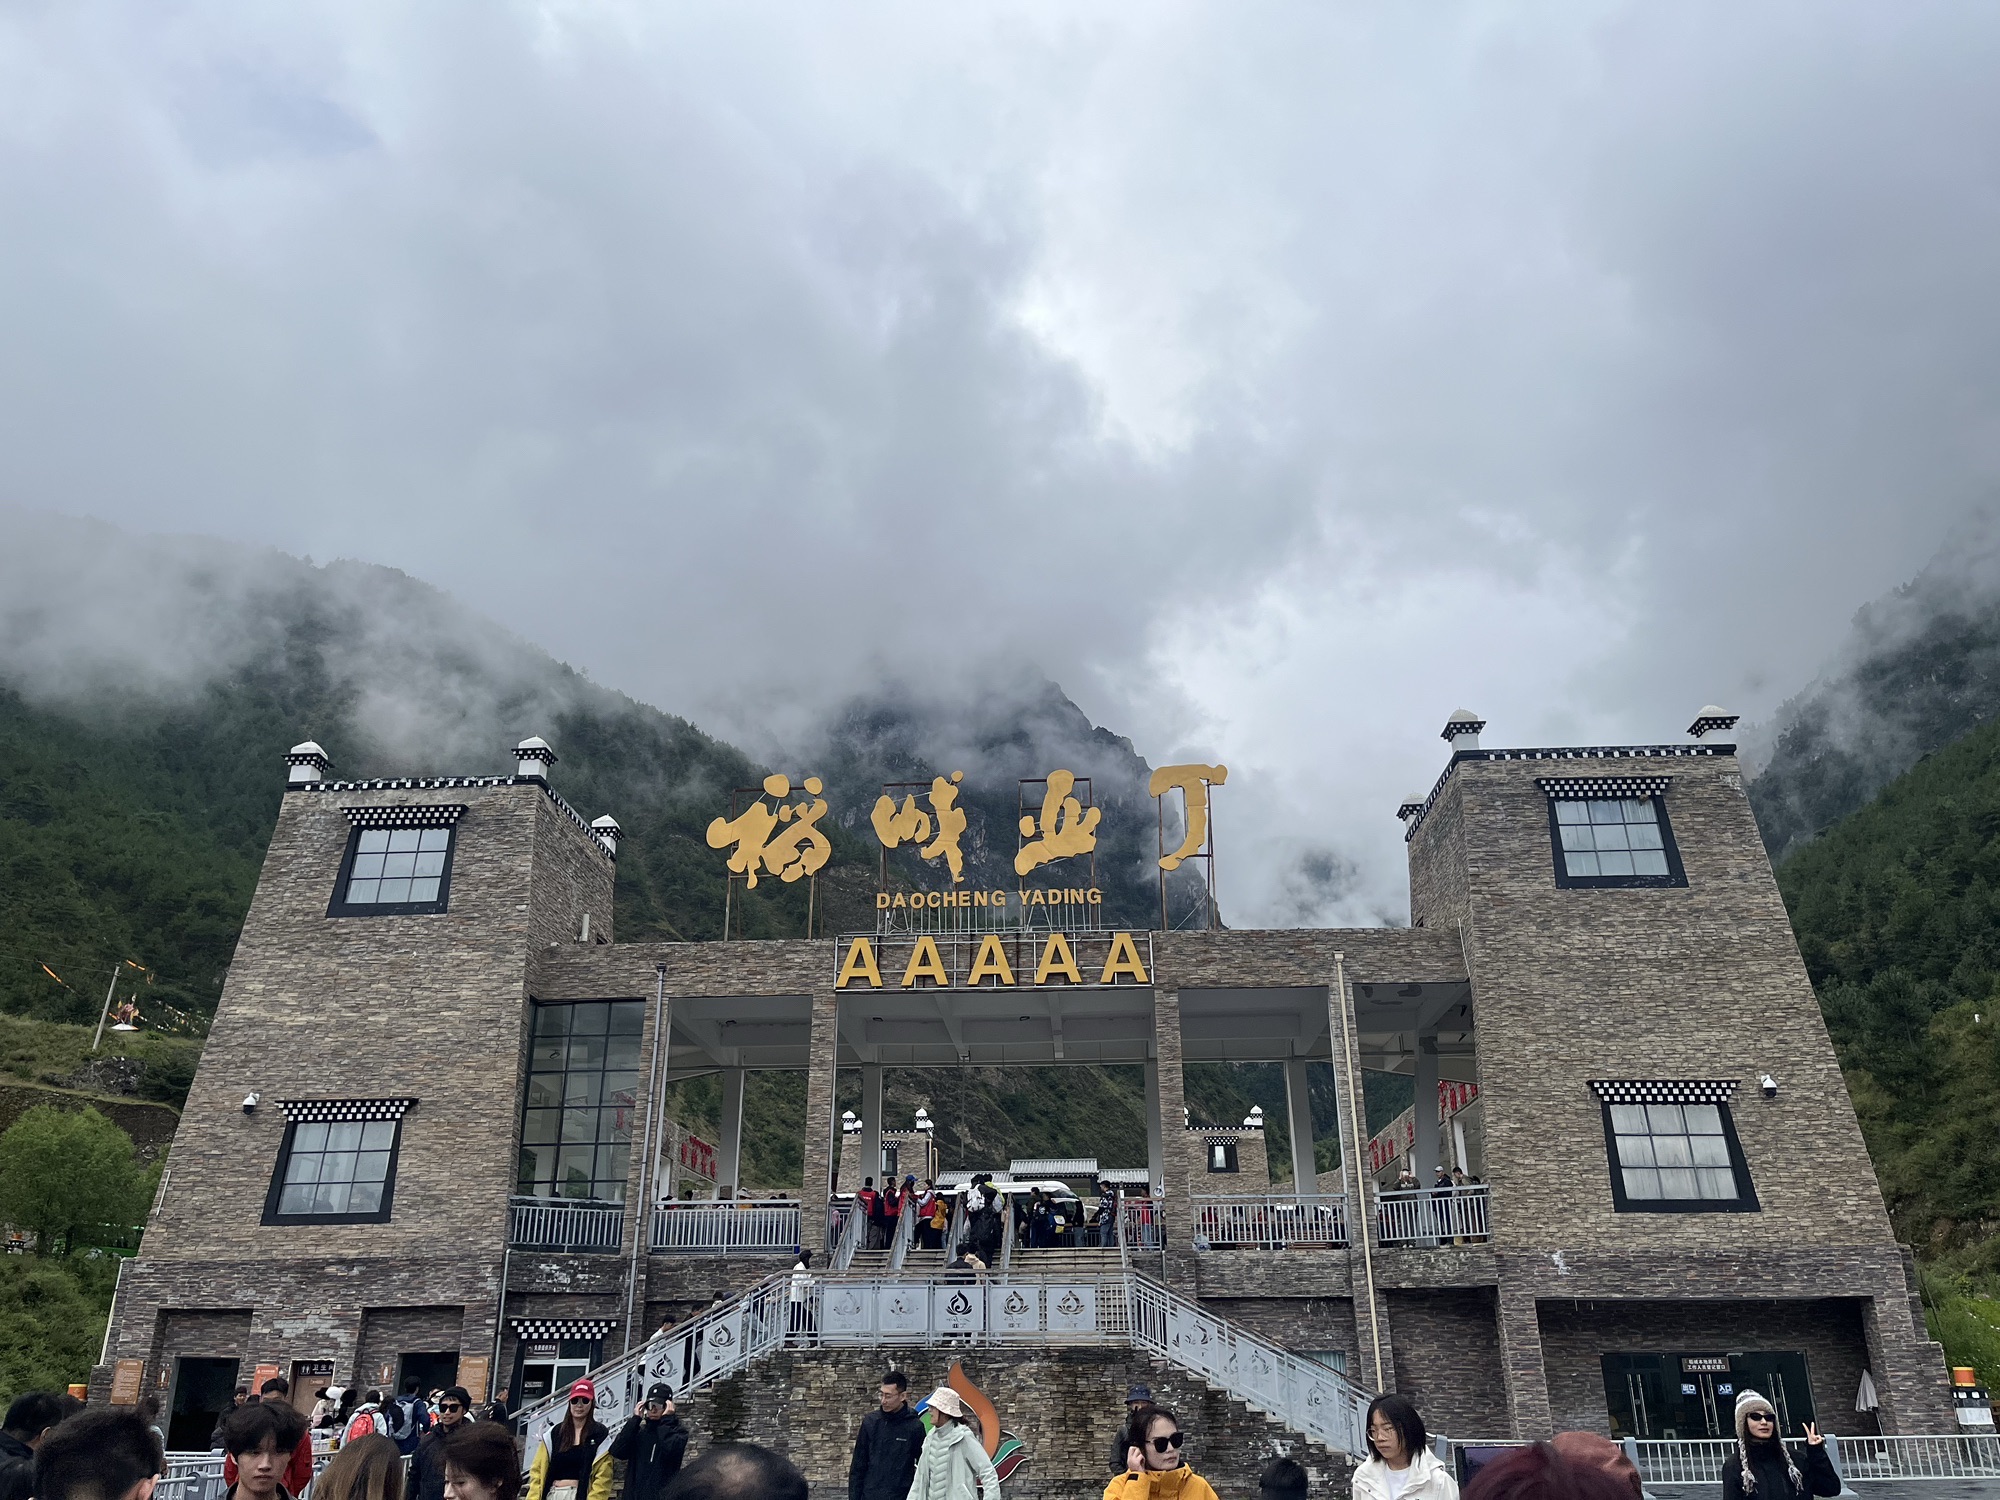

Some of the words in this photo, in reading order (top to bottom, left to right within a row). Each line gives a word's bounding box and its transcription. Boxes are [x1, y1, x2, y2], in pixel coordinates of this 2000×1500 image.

[706, 764, 1228, 889] 稻城亚丁
[876, 890, 1006, 909] DAOCHENG
[1018, 887, 1101, 906] YADING
[1719, 1384, 1732, 1392] 入口
